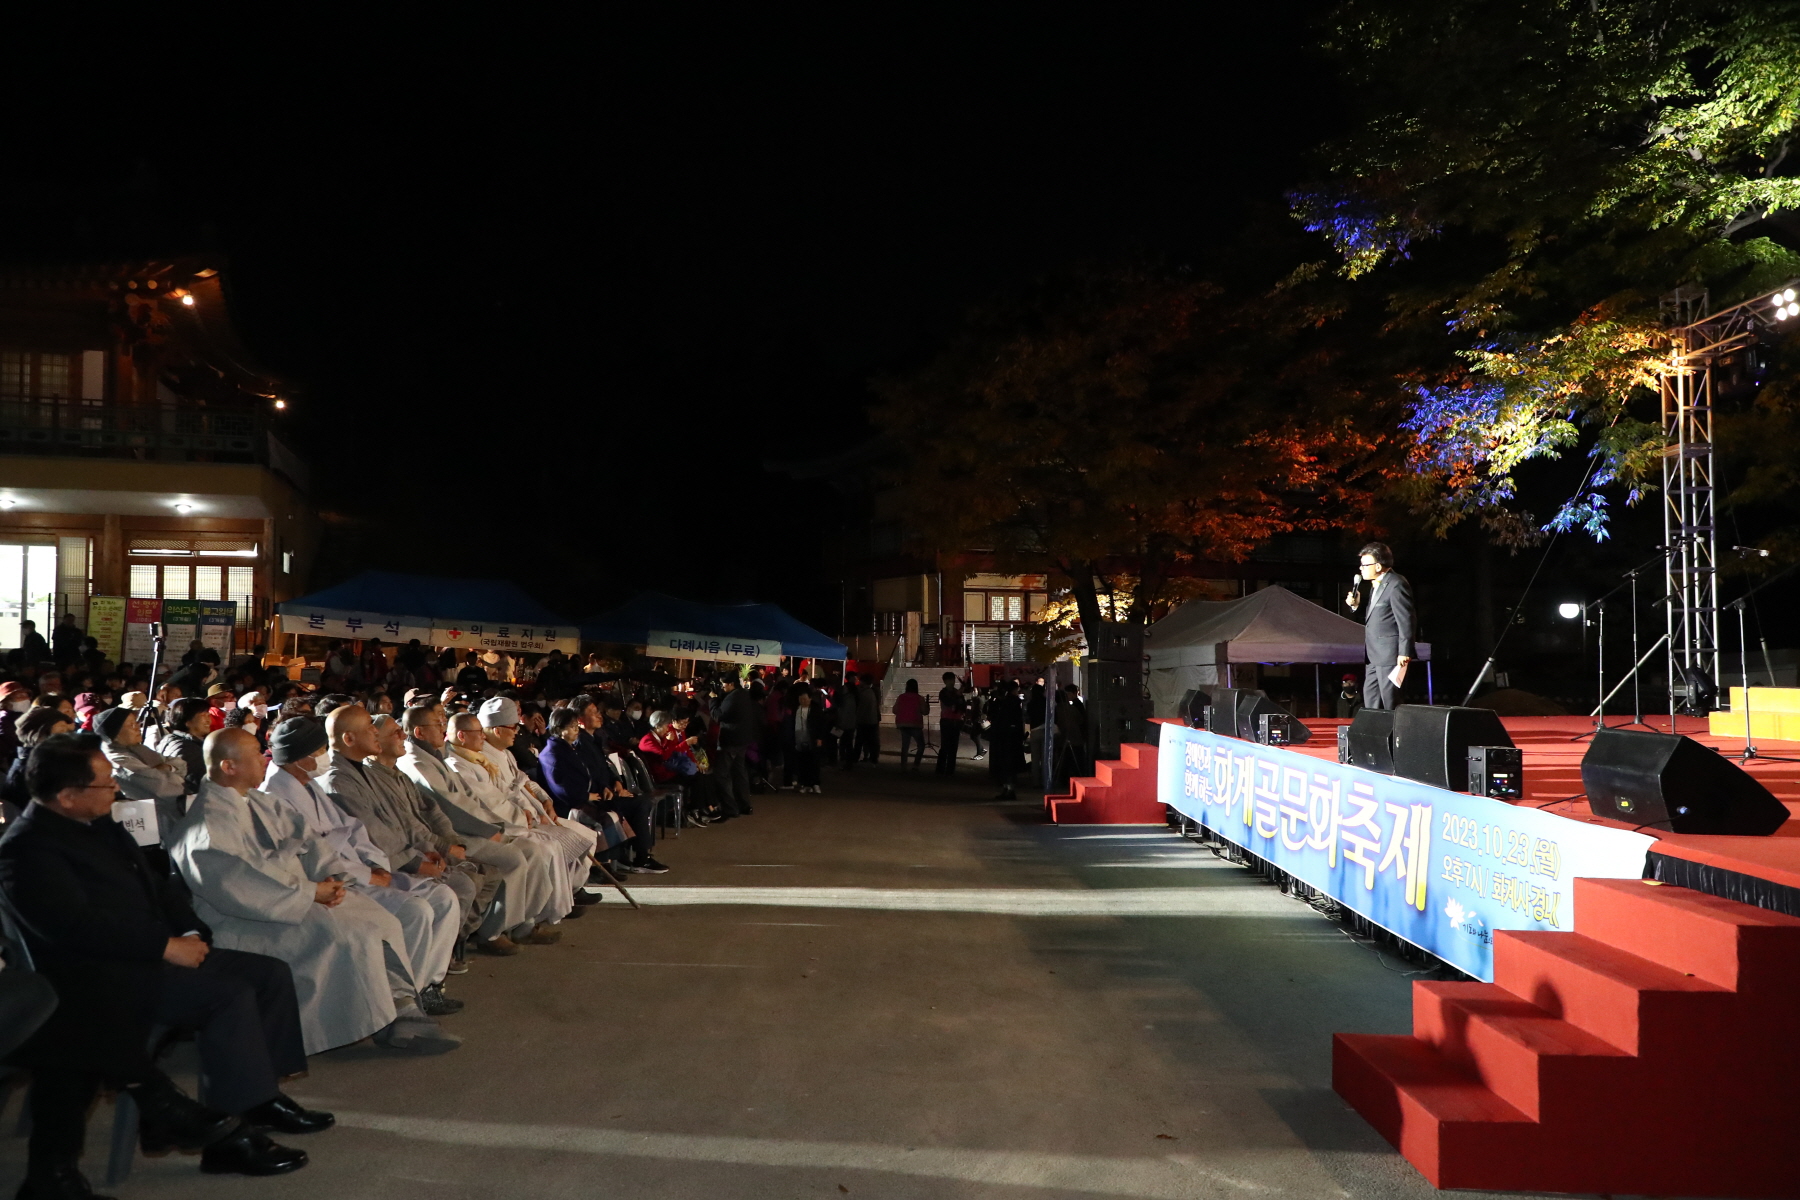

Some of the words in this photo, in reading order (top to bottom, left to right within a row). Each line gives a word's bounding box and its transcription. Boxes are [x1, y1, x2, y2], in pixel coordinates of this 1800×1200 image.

[167, 605, 198, 615] 의식교육
[203, 607, 234, 616] 불교입문
[669, 639, 720, 654] 다례시음
[725, 642, 760, 658] (무료)
